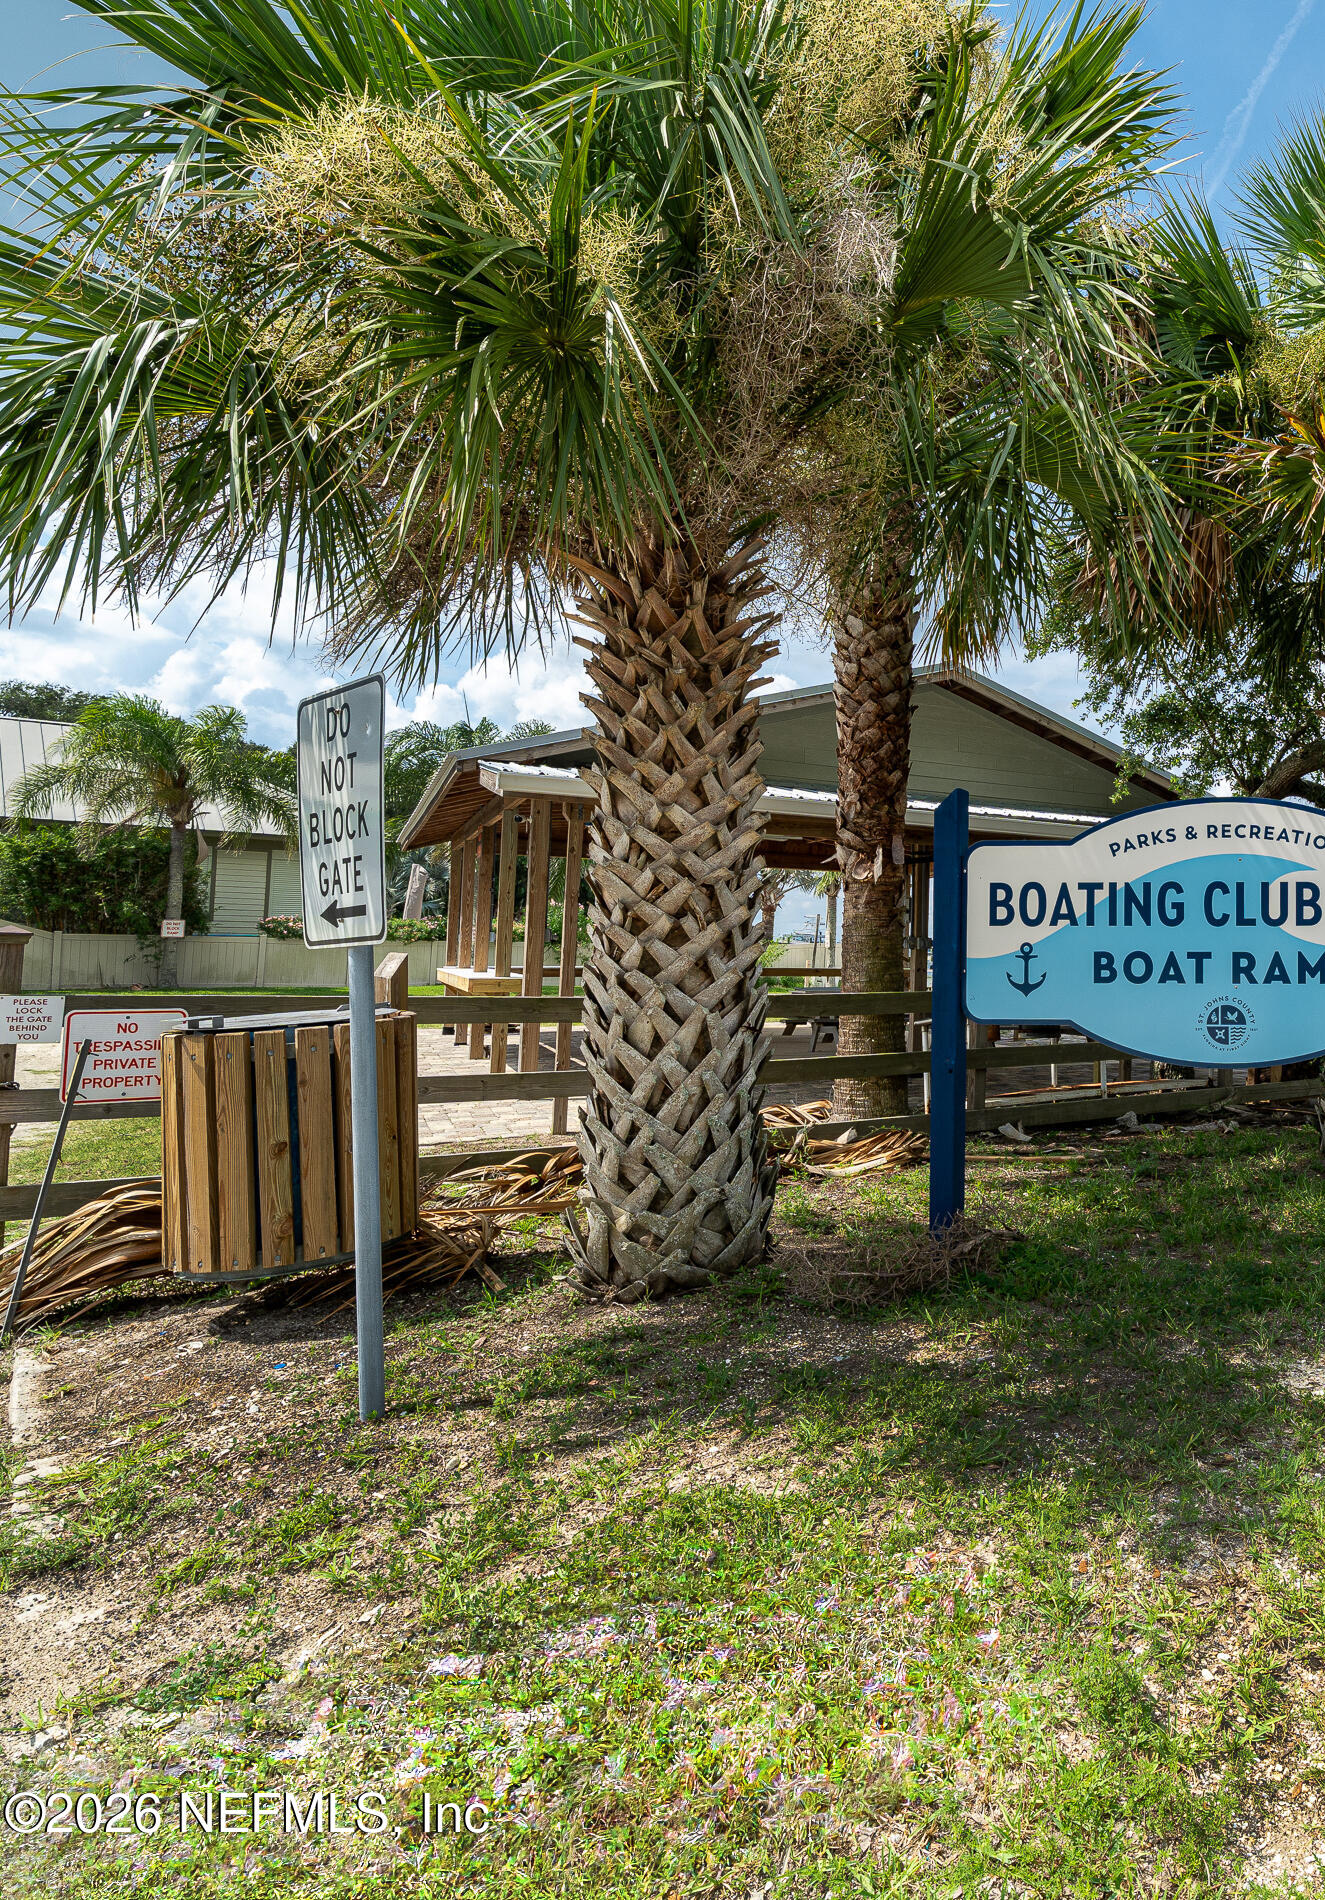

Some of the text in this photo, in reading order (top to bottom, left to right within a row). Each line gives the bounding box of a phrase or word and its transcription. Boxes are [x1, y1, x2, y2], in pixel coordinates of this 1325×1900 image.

[327, 702, 351, 742] DO
[321, 752, 357, 796] NOT
[309, 800, 370, 848] BLOCK
[1108, 828, 1177, 857] PARKS
[1185, 826, 1198, 840] &
[319, 855, 364, 897] GATE
[988, 881, 1186, 928] BOATING
[1204, 880, 1323, 928] CLUB
[1092, 951, 1212, 985] BOAT
[13, 998, 48, 1006] PLEASE
[1204, 995, 1229, 1011] JOHNS
[1232, 997, 1256, 1024] COUNTY
[9, 1024, 48, 1032] BEHIND
[17, 1033, 39, 1041] YOU
[117, 1022, 139, 1034] NO
[73, 1039, 161, 1053] TESPASSI
[93, 1057, 157, 1071] PRIVATE
[81, 1074, 161, 1089] PROPERTY
